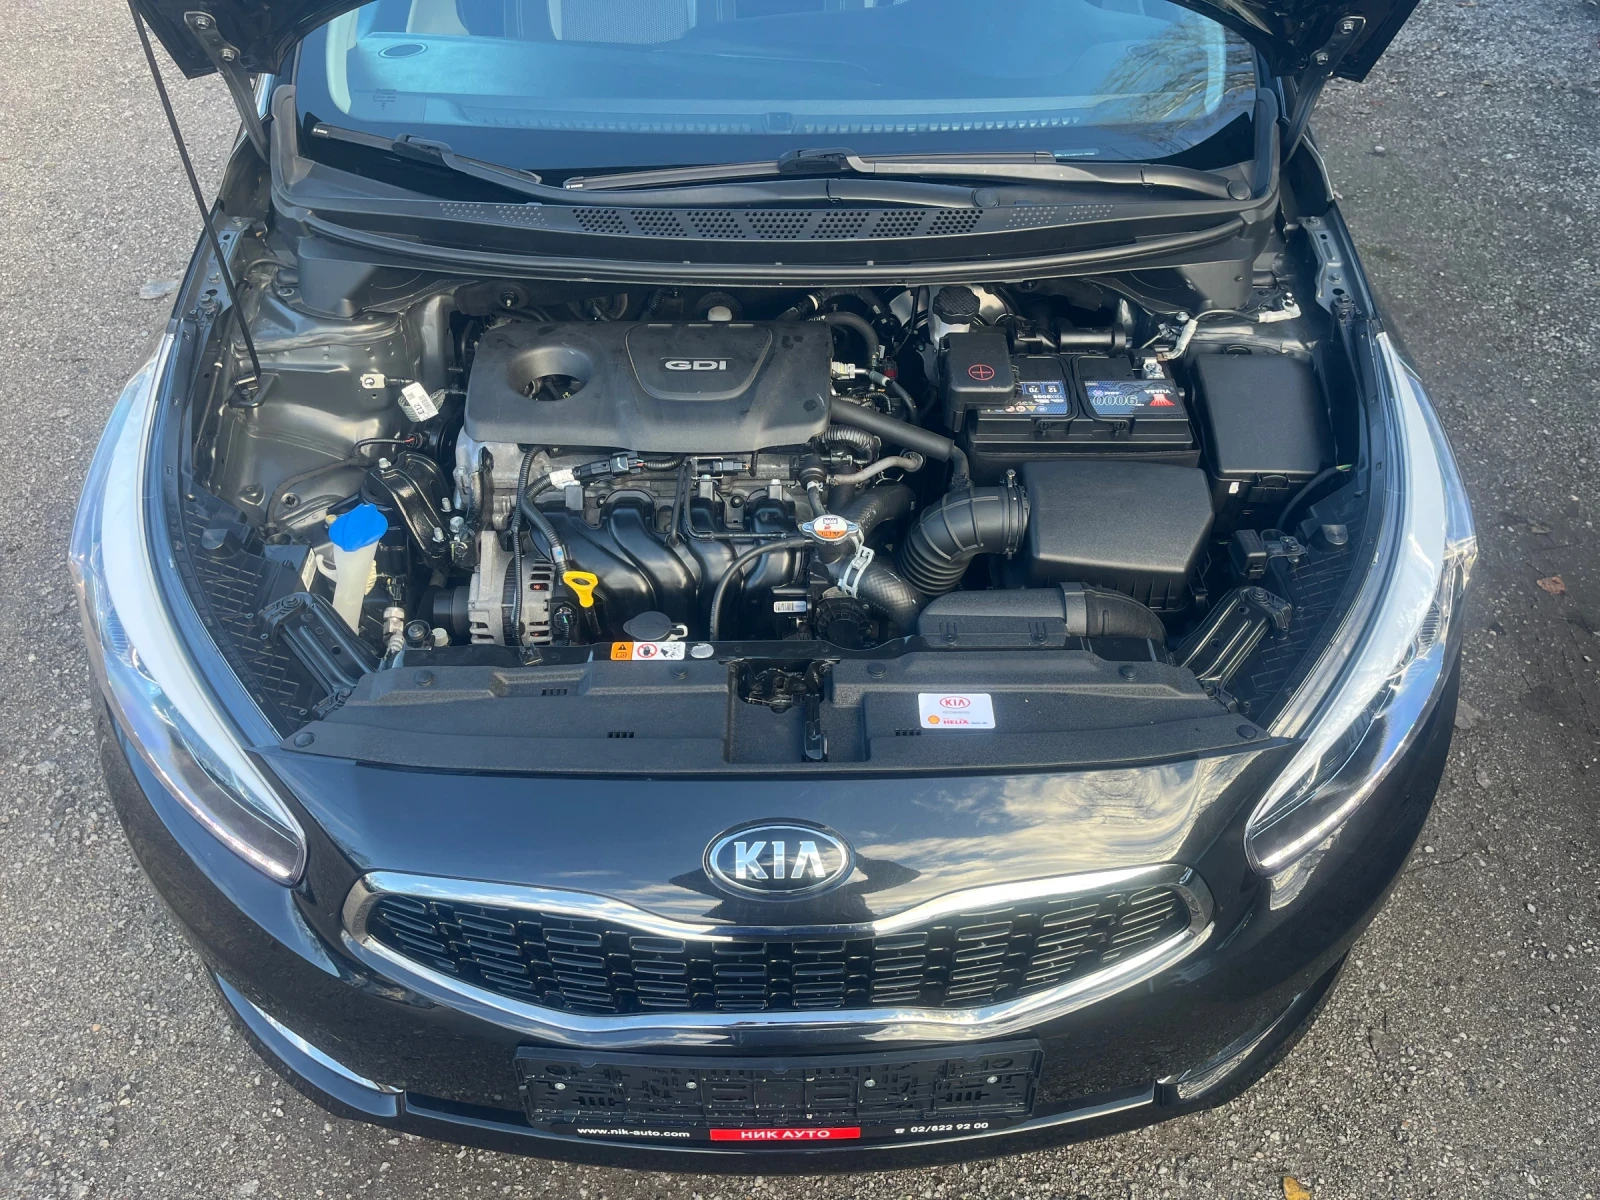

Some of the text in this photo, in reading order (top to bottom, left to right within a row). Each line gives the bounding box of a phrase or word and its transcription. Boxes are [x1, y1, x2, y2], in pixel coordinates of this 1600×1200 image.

[664, 360, 727, 371] GDI
[1092, 394, 1138, 406] 9000
[945, 698, 966, 707] KIA
[733, 840, 827, 880] KIA
[576, 1127, 691, 1138] www.nik-auto.com
[910, 1121, 989, 1133] 02/822 92 00
[740, 1128, 831, 1140] НИК АУТО
